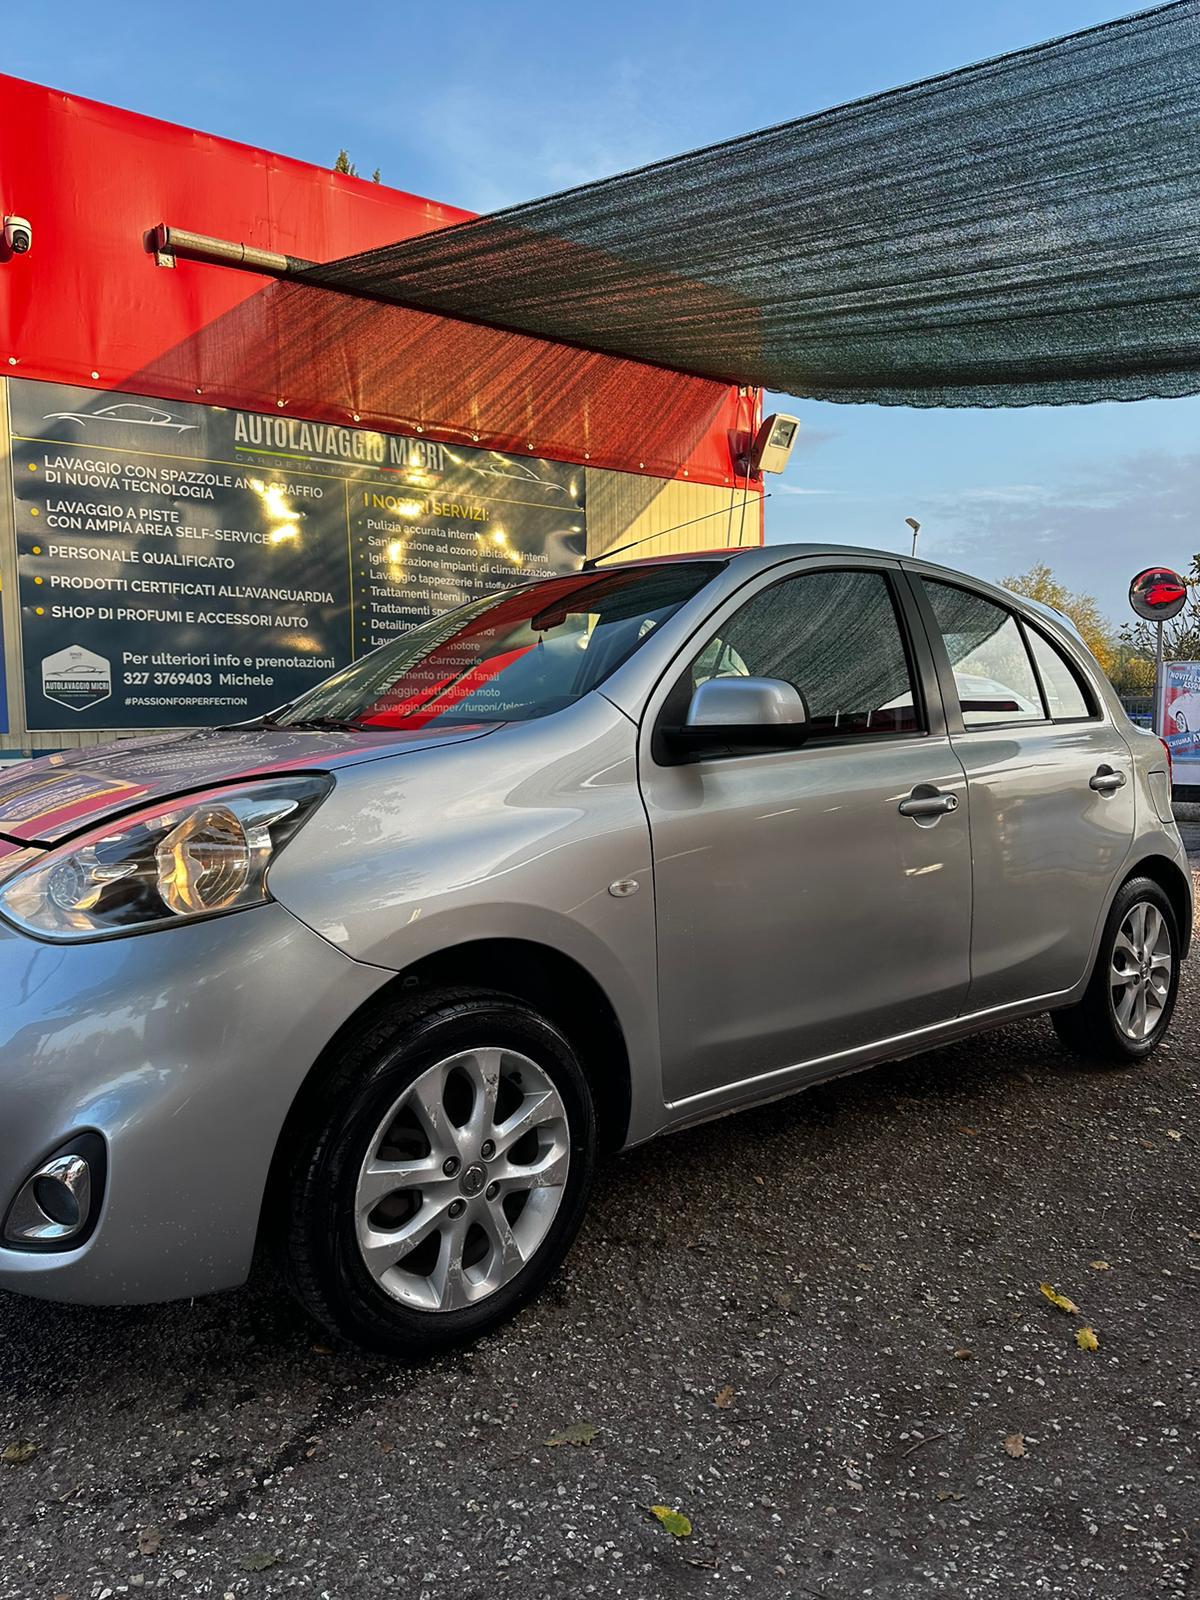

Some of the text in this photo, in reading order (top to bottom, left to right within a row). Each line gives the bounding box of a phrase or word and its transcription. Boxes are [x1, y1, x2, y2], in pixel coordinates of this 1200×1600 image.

[234, 413, 445, 471] AUTOLAVAGGIO MICRI
[44, 454, 121, 476] LAVAGGIO
[125, 465, 158, 480] CON
[160, 469, 232, 488] SPAZZOLE
[45, 470, 214, 500] DI NUOVA TECNOLOGIA
[46, 500, 180, 523] LAVAGGIO A PISTE
[363, 493, 368, 507] I
[433, 502, 490, 521] SERVIZI:
[47, 515, 270, 545] CON AMPIA AREA SELF-SERVICE
[367, 519, 401, 533] Pulizia
[404, 525, 446, 539] accurata
[48, 545, 235, 570] PERSONALE QUALIFICATO
[436, 543, 448, 553] ad
[450, 547, 478, 557] ozono
[521, 552, 549, 563] interni
[441, 559, 479, 573] impianti
[480, 562, 489, 573] di
[491, 564, 557, 579] climatizzazione
[51, 576, 334, 604] PRODOTTI CERTIFICATI ALL'AVANGUARDIA
[370, 569, 416, 586] Lavaggio
[418, 574, 473, 591] tappezzerie
[475, 577, 483, 588] in
[370, 586, 429, 600] Trattamenti
[431, 589, 461, 602] interni
[462, 592, 471, 602] in
[52, 605, 309, 628] SHOP DI PROFUMI E ACCESSORI AUTO
[371, 603, 430, 616] Trattamenti
[371, 619, 418, 631] Detailing
[123, 652, 335, 670] Per ulteriori info e prenotazioni
[46, 681, 89, 690] AUTOLAVAGGIO
[123, 672, 274, 686] 327 3769403 Michele
[474, 672, 499, 682] fanali
[125, 696, 247, 706] #PASSIONFORPERFECTION
[374, 686, 500, 699] Lavaggio dettagliato moto
[374, 703, 419, 715] Lavaggio
